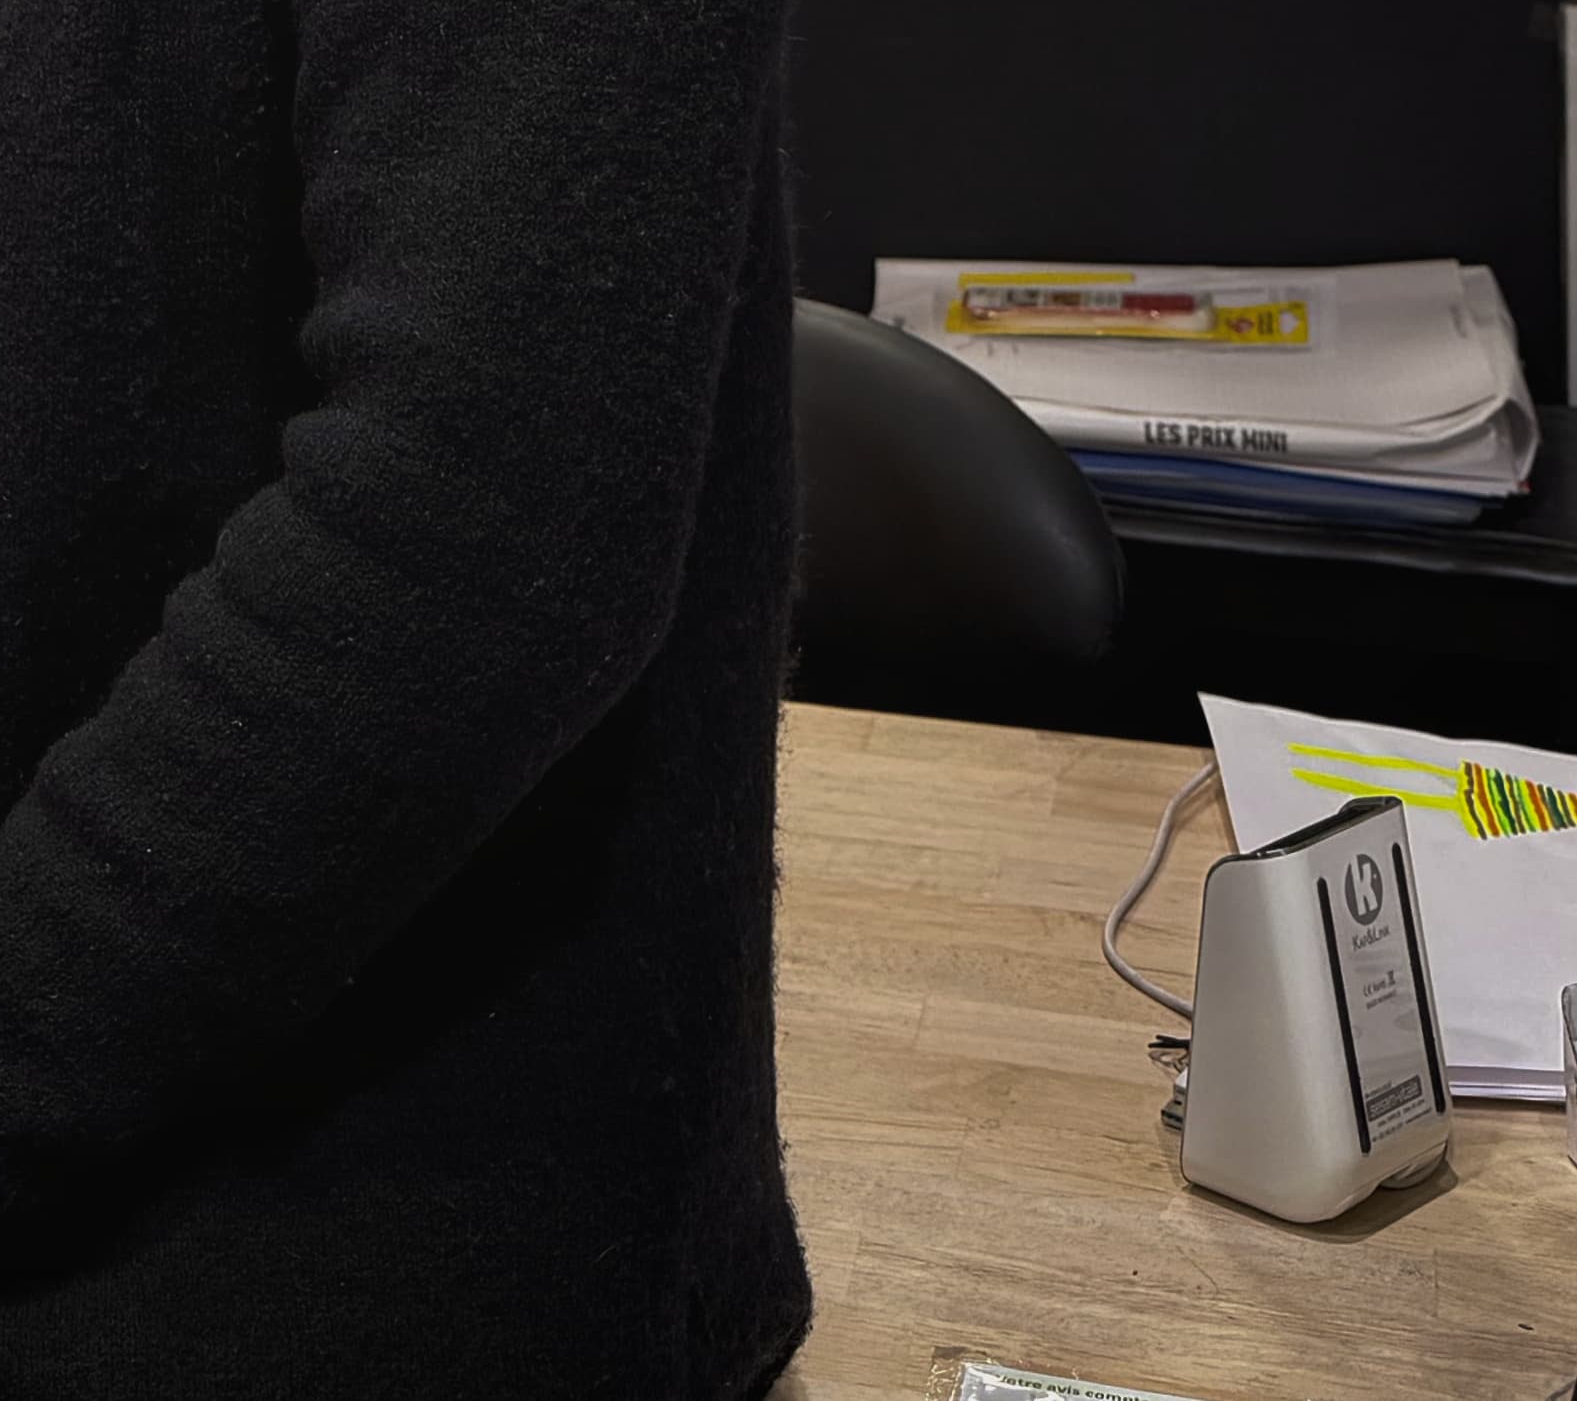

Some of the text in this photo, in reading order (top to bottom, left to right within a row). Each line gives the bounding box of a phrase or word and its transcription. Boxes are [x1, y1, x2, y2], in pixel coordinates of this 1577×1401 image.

[1144, 421, 1288, 452] LES PRIX MINI
[1047, 1384, 1081, 1396] avis
